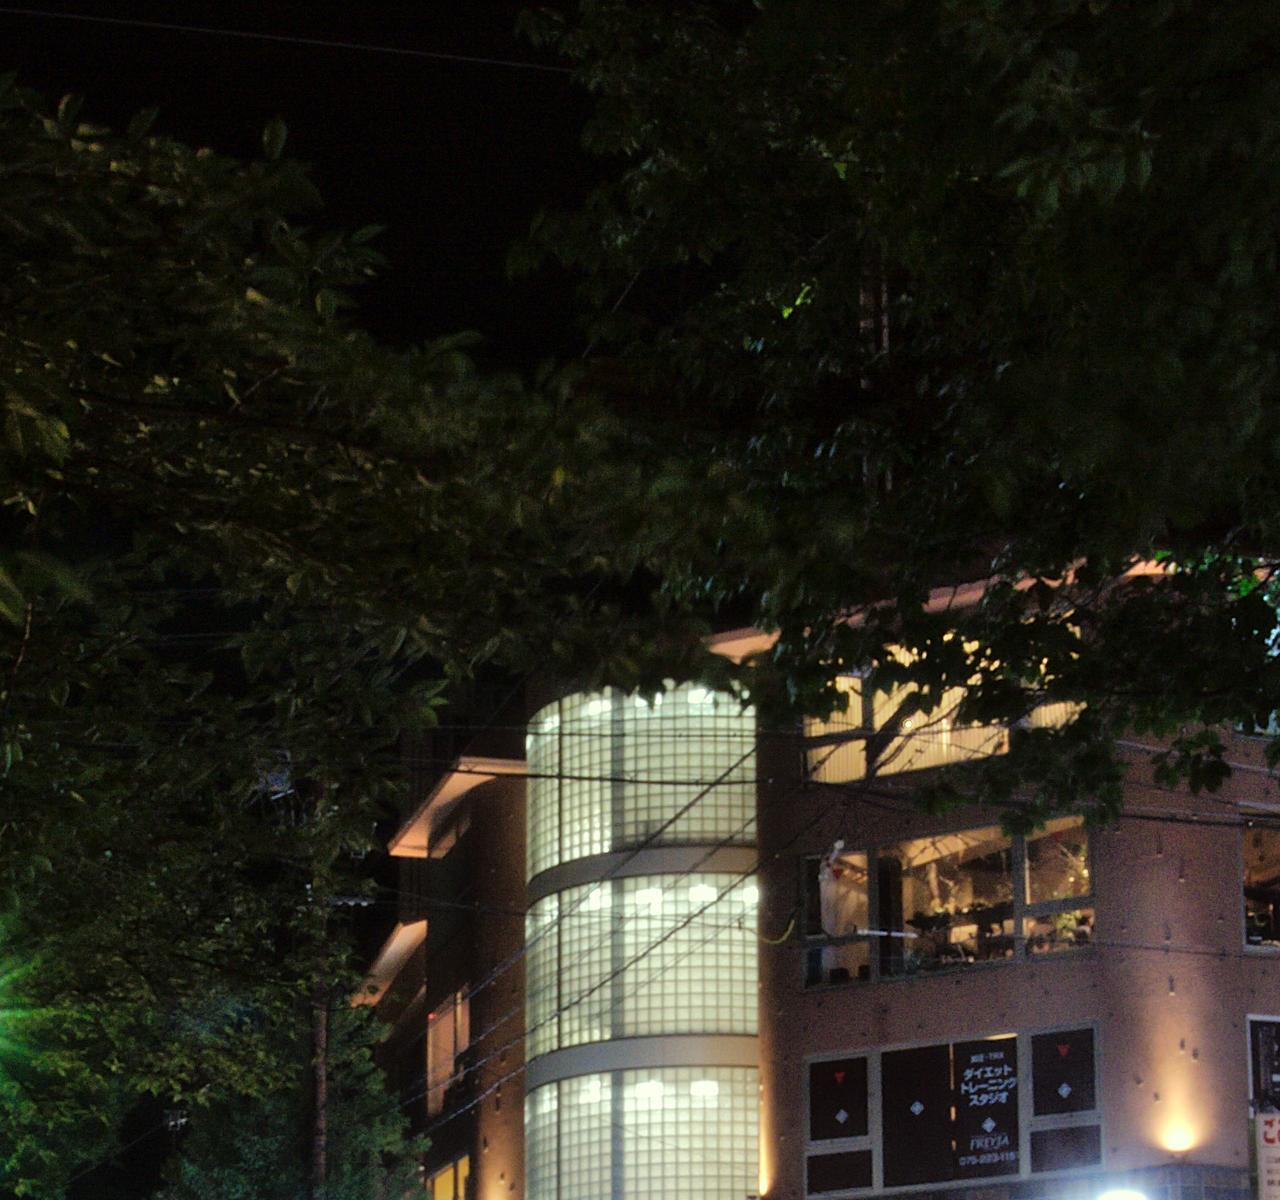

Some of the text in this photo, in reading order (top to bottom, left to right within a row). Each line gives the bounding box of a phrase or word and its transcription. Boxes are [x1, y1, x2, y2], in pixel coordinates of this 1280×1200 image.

[963, 1064, 1013, 1080] ダイエット
[961, 1077, 1017, 1094] トレーニング
[969, 1092, 1009, 1106] スタジオ
